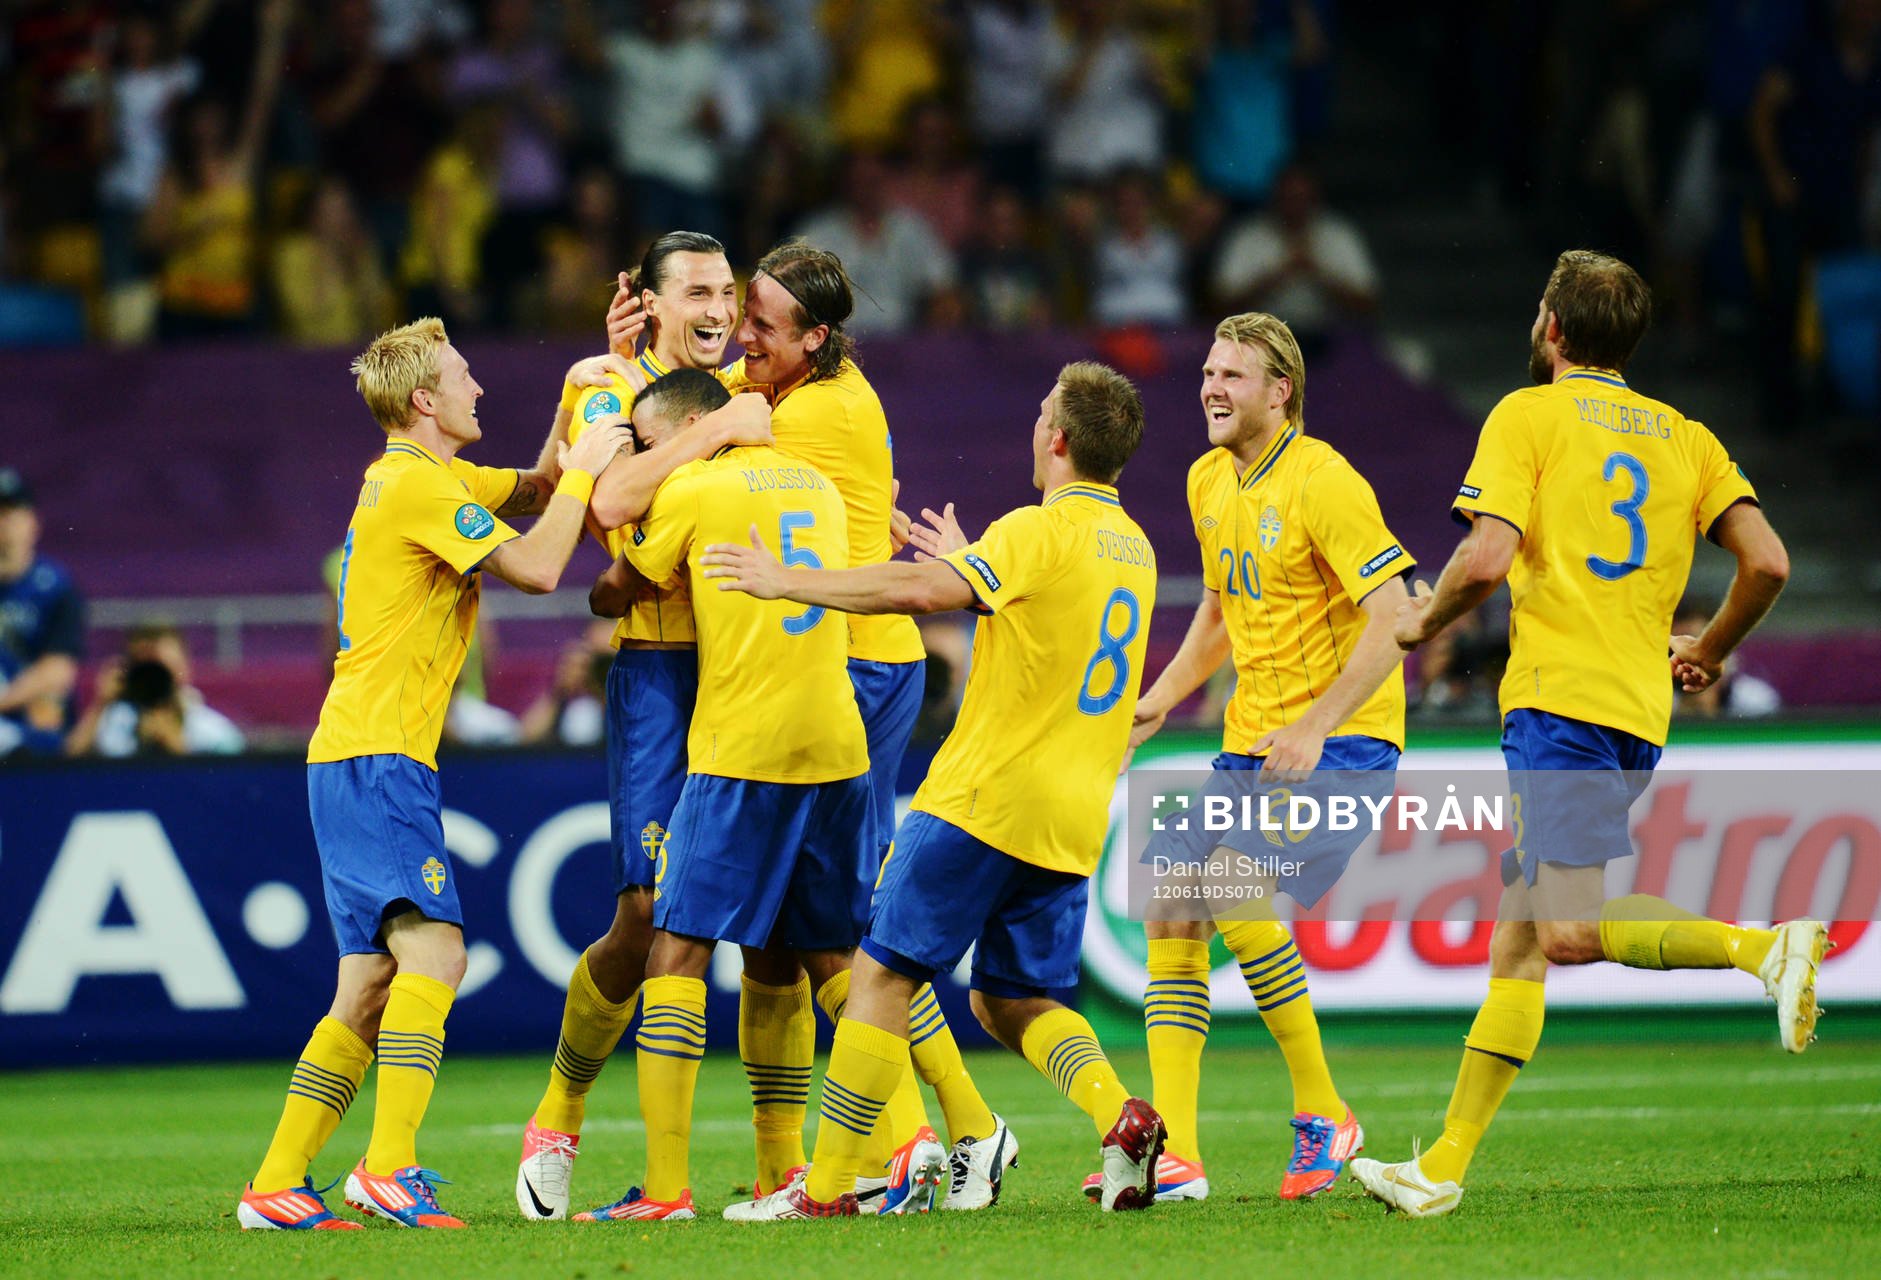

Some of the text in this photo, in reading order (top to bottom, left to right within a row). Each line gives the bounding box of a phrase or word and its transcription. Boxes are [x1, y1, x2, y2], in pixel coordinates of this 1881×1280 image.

[1573, 397, 1672, 439] MELLBERG
[1586, 452, 1650, 581] 3
[779, 510, 827, 636] 5
[975, 560, 1000, 590] RESPECT
[1220, 547, 1262, 601] 20
[1369, 546, 1401, 570] RESPECT
[1077, 587, 1140, 716] 8
